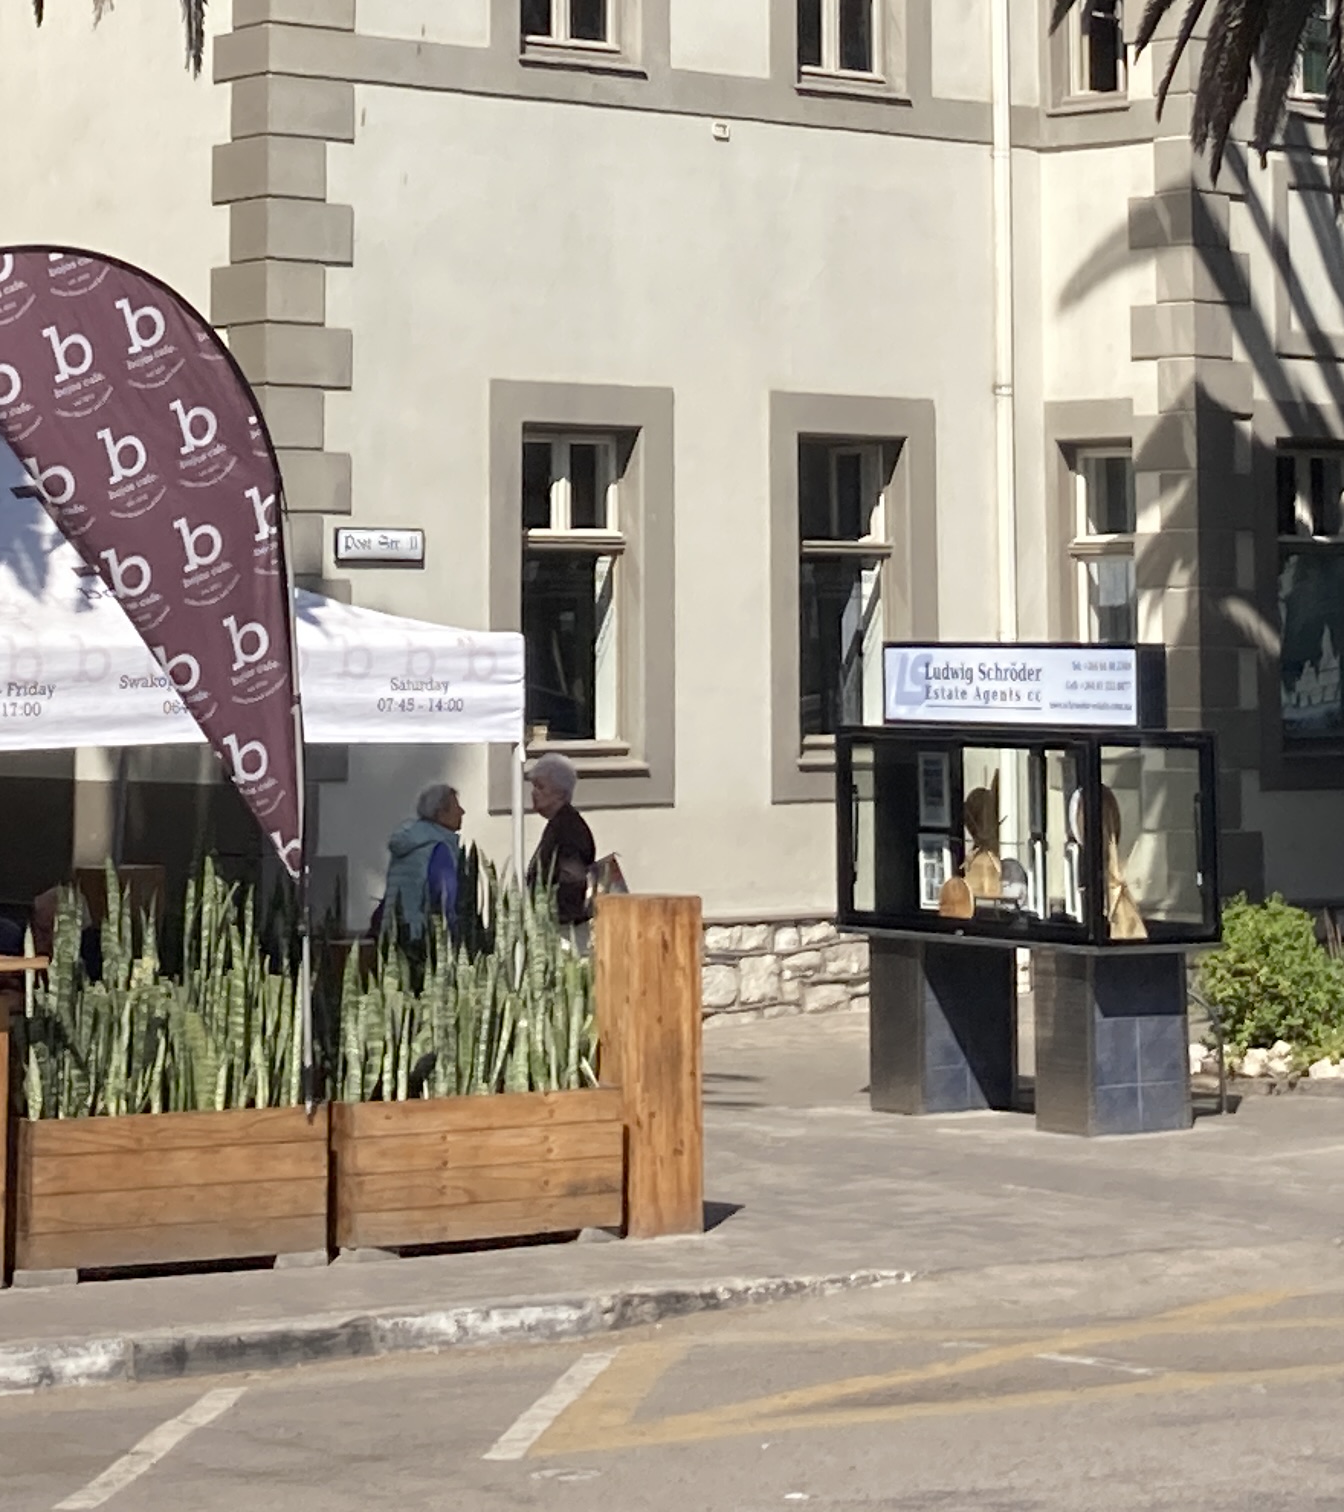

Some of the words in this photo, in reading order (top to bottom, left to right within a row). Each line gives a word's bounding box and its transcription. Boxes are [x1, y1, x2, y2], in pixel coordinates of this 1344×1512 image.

[114, 297, 165, 354] b
[42, 325, 93, 384] b
[169, 399, 217, 455] b
[97, 427, 147, 485] b
[173, 517, 222, 574] b
[100, 547, 151, 599] b
[223, 615, 269, 671] b
[6, 681, 56, 700] Friday
[156, 646, 201, 692] b
[389, 676, 450, 695] Saturday
[924, 661, 974, 685] Ludwig
[978, 661, 1043, 682] Schröder
[1, 701, 42, 718] 17:00
[428, 697, 464, 713] 14:00
[925, 685, 968, 701] Estate
[973, 686, 1022, 705] Agents
[222, 733, 268, 784] b
